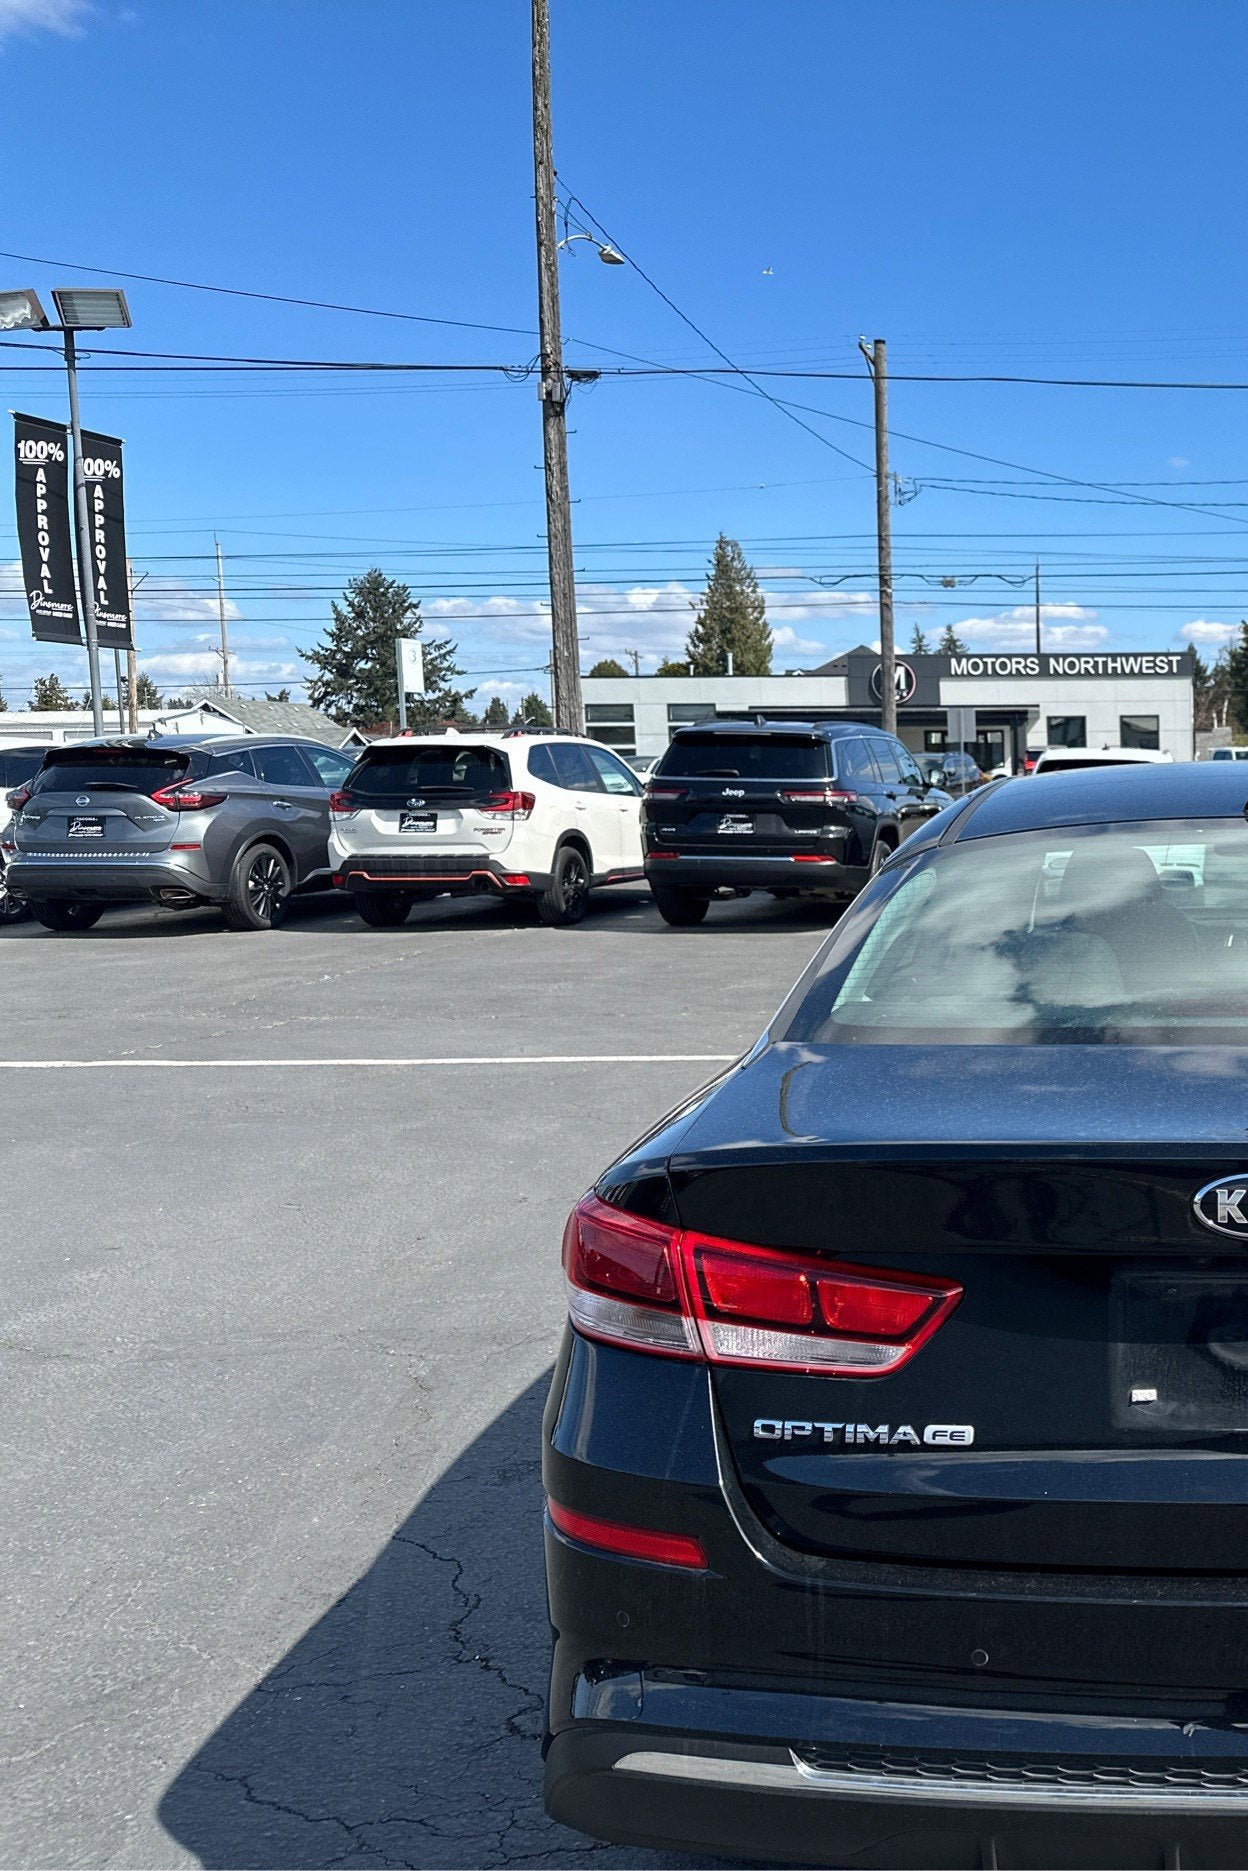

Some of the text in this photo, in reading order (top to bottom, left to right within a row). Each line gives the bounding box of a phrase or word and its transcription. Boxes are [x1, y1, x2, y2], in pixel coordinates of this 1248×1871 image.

[17, 440, 65, 462] 100%
[81, 457, 121, 479] 00%
[35, 467, 53, 595] APPROVAL
[93, 484, 109, 606] APPROVAL
[950, 656, 1182, 676] MOTORS NORTHWEST
[721, 787, 746, 798] Jeep
[753, 1418, 969, 1446] OPTIMA FE
